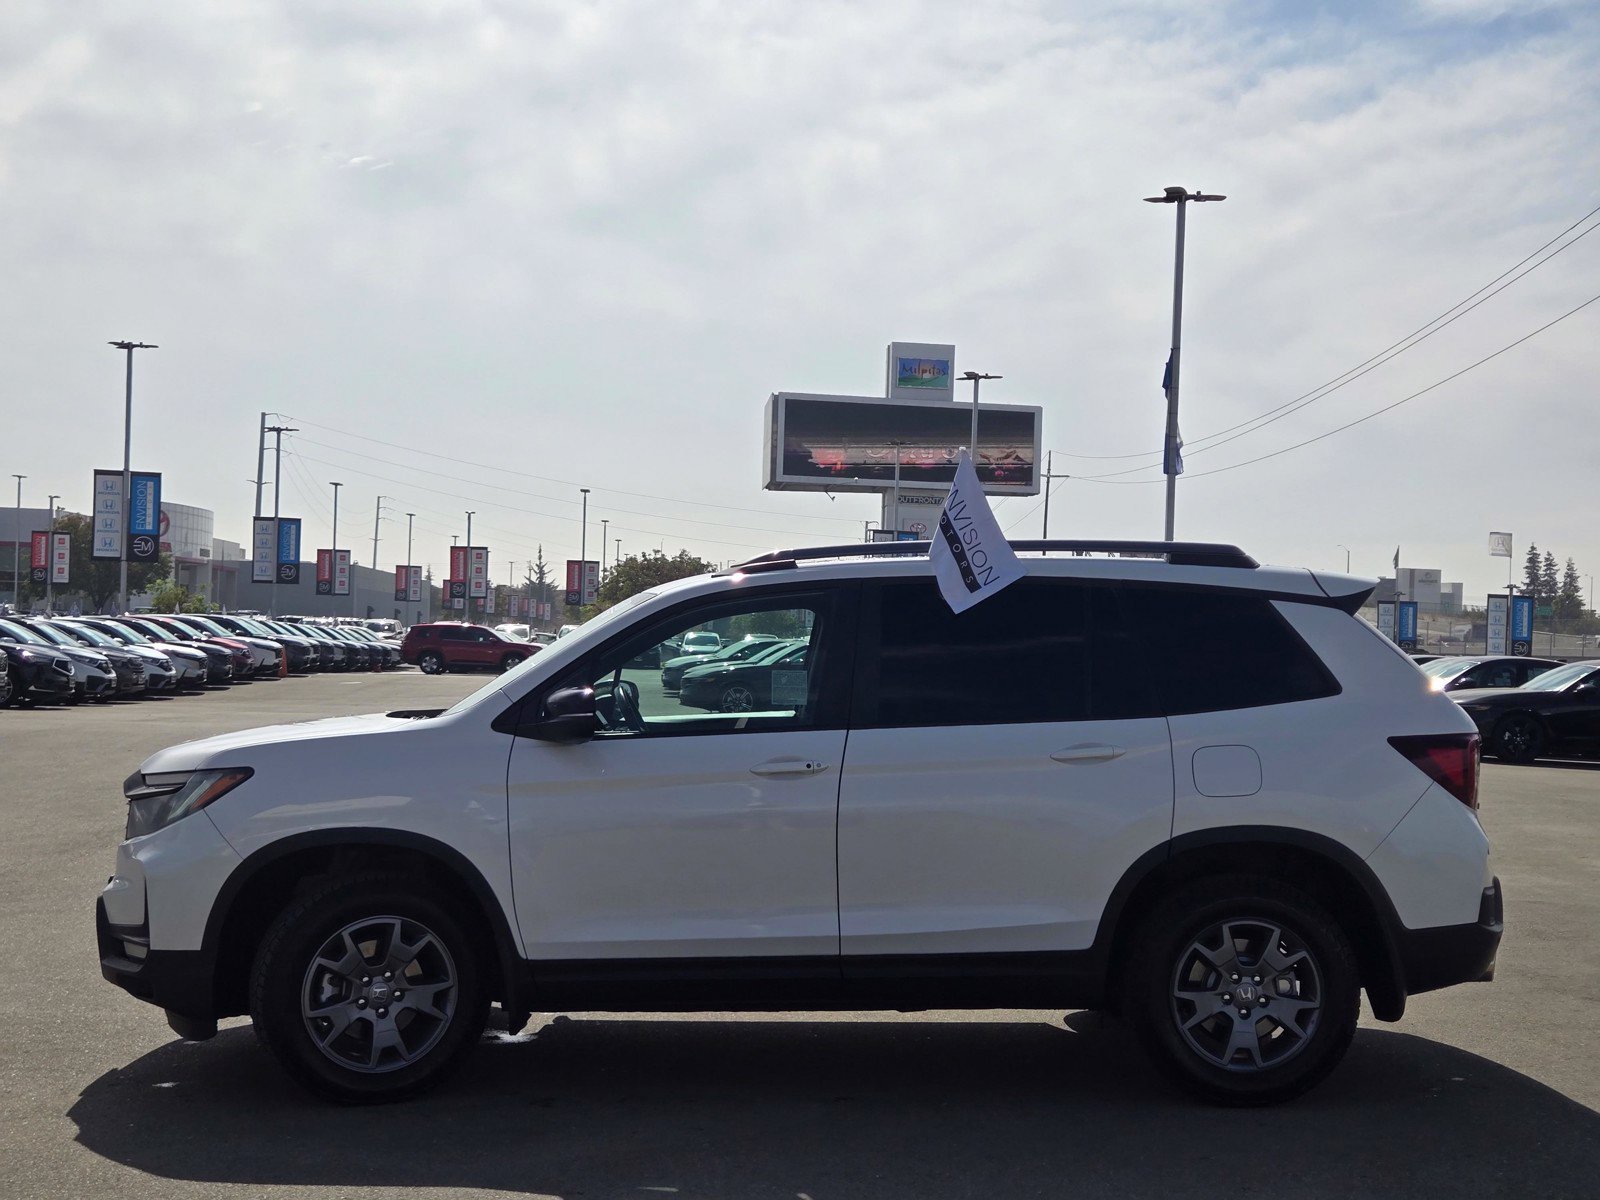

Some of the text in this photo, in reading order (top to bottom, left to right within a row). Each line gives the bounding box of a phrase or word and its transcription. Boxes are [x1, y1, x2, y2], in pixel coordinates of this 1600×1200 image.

[902, 361, 947, 379] Milpitas
[136, 480, 147, 530] ENVISION
[947, 481, 1000, 587] NVISION
[940, 515, 974, 583] OTORS
